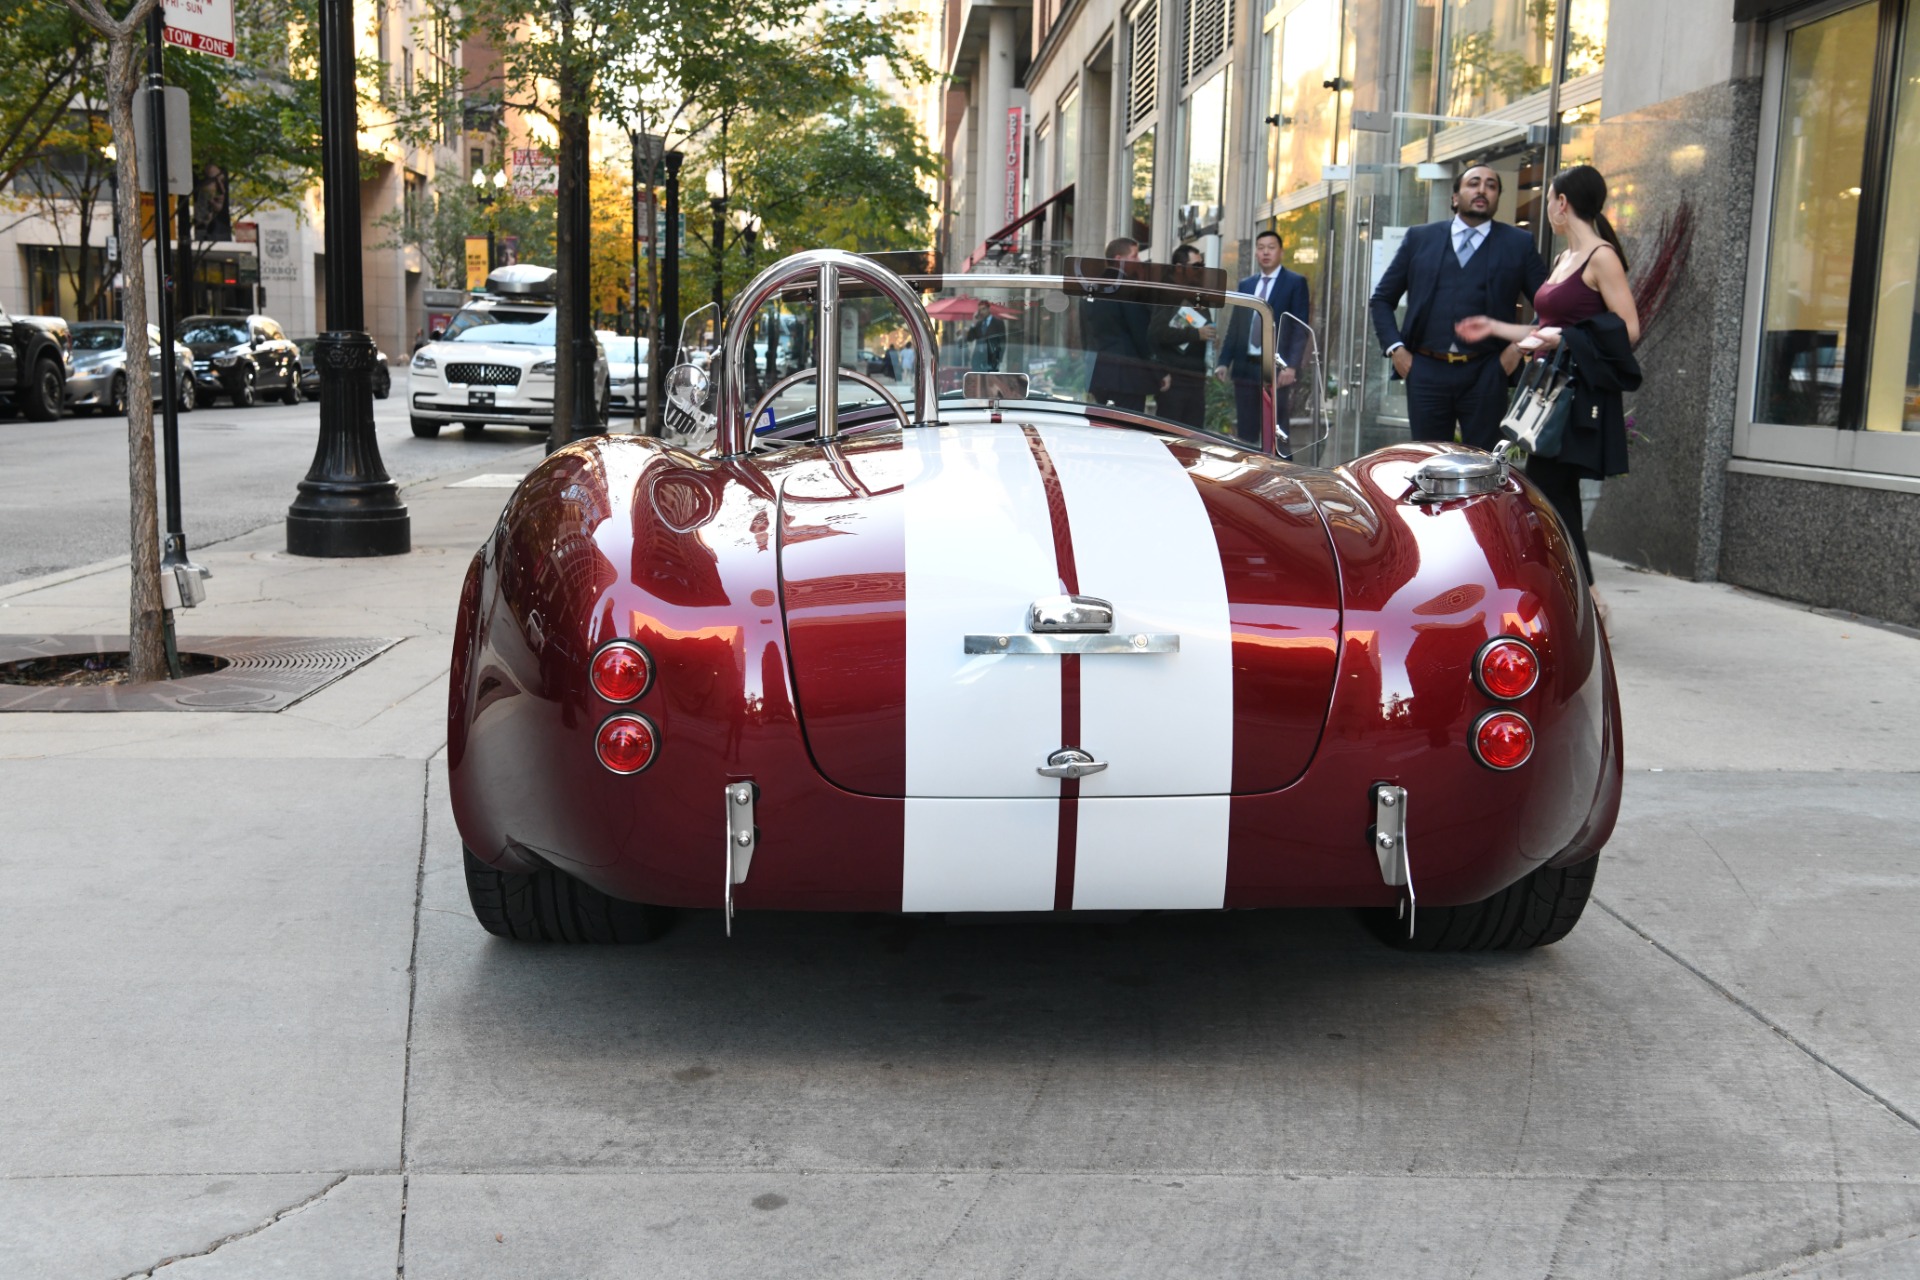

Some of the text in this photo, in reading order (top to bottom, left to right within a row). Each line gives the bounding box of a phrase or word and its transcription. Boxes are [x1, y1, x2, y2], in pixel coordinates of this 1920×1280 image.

[186, 1, 203, 15] SUN
[167, 27, 230, 56] TOW ZONE
[1007, 113, 1017, 166] EPIC
